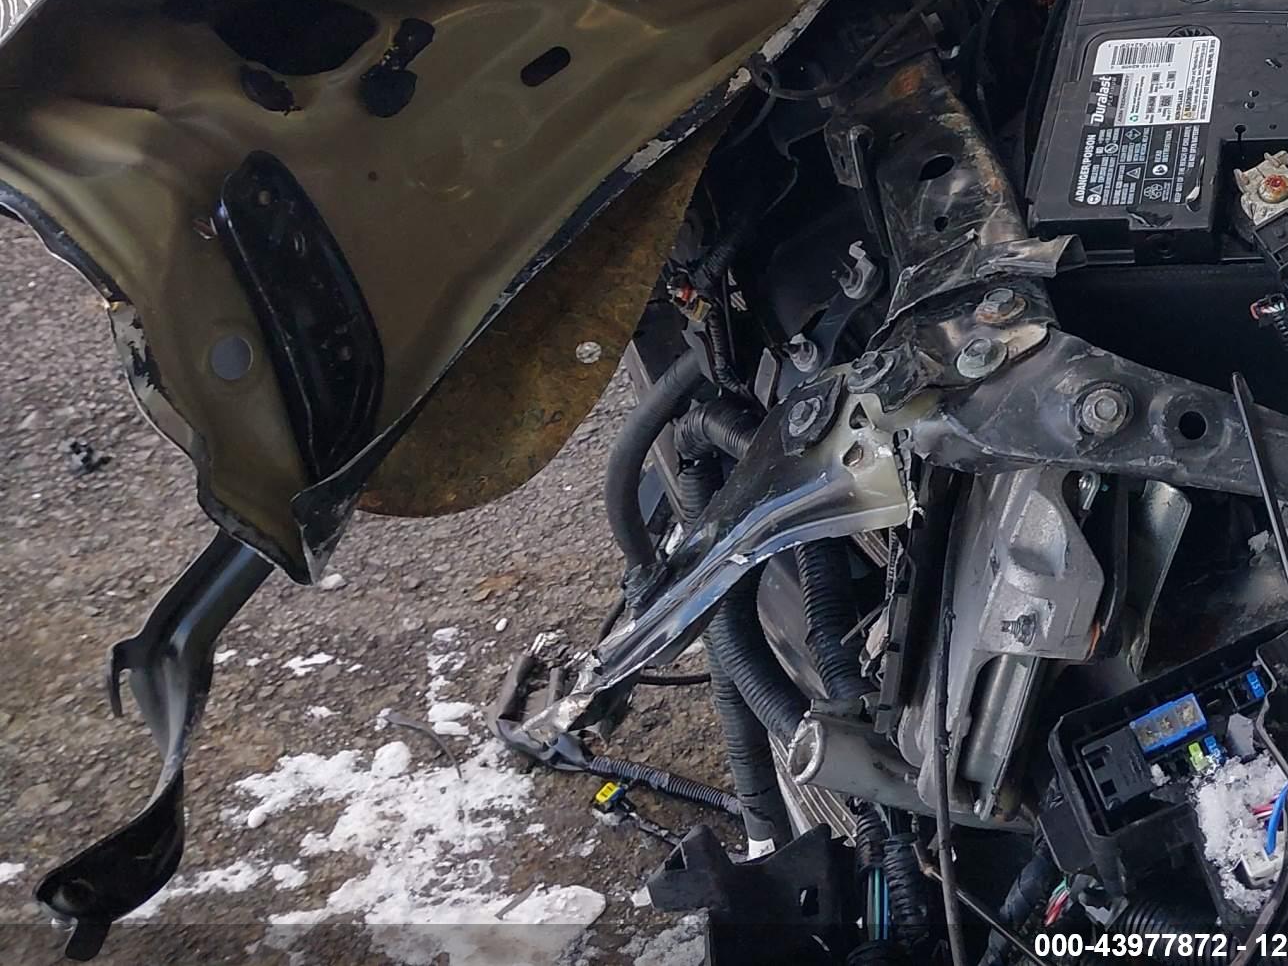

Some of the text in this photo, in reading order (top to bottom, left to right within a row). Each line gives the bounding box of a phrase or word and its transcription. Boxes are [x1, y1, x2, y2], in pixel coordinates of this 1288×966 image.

[1090, 75, 1112, 124] Duralast
[1107, 77, 1116, 105] PLATINUM
[1076, 134, 1096, 195] DANGER/POISON
